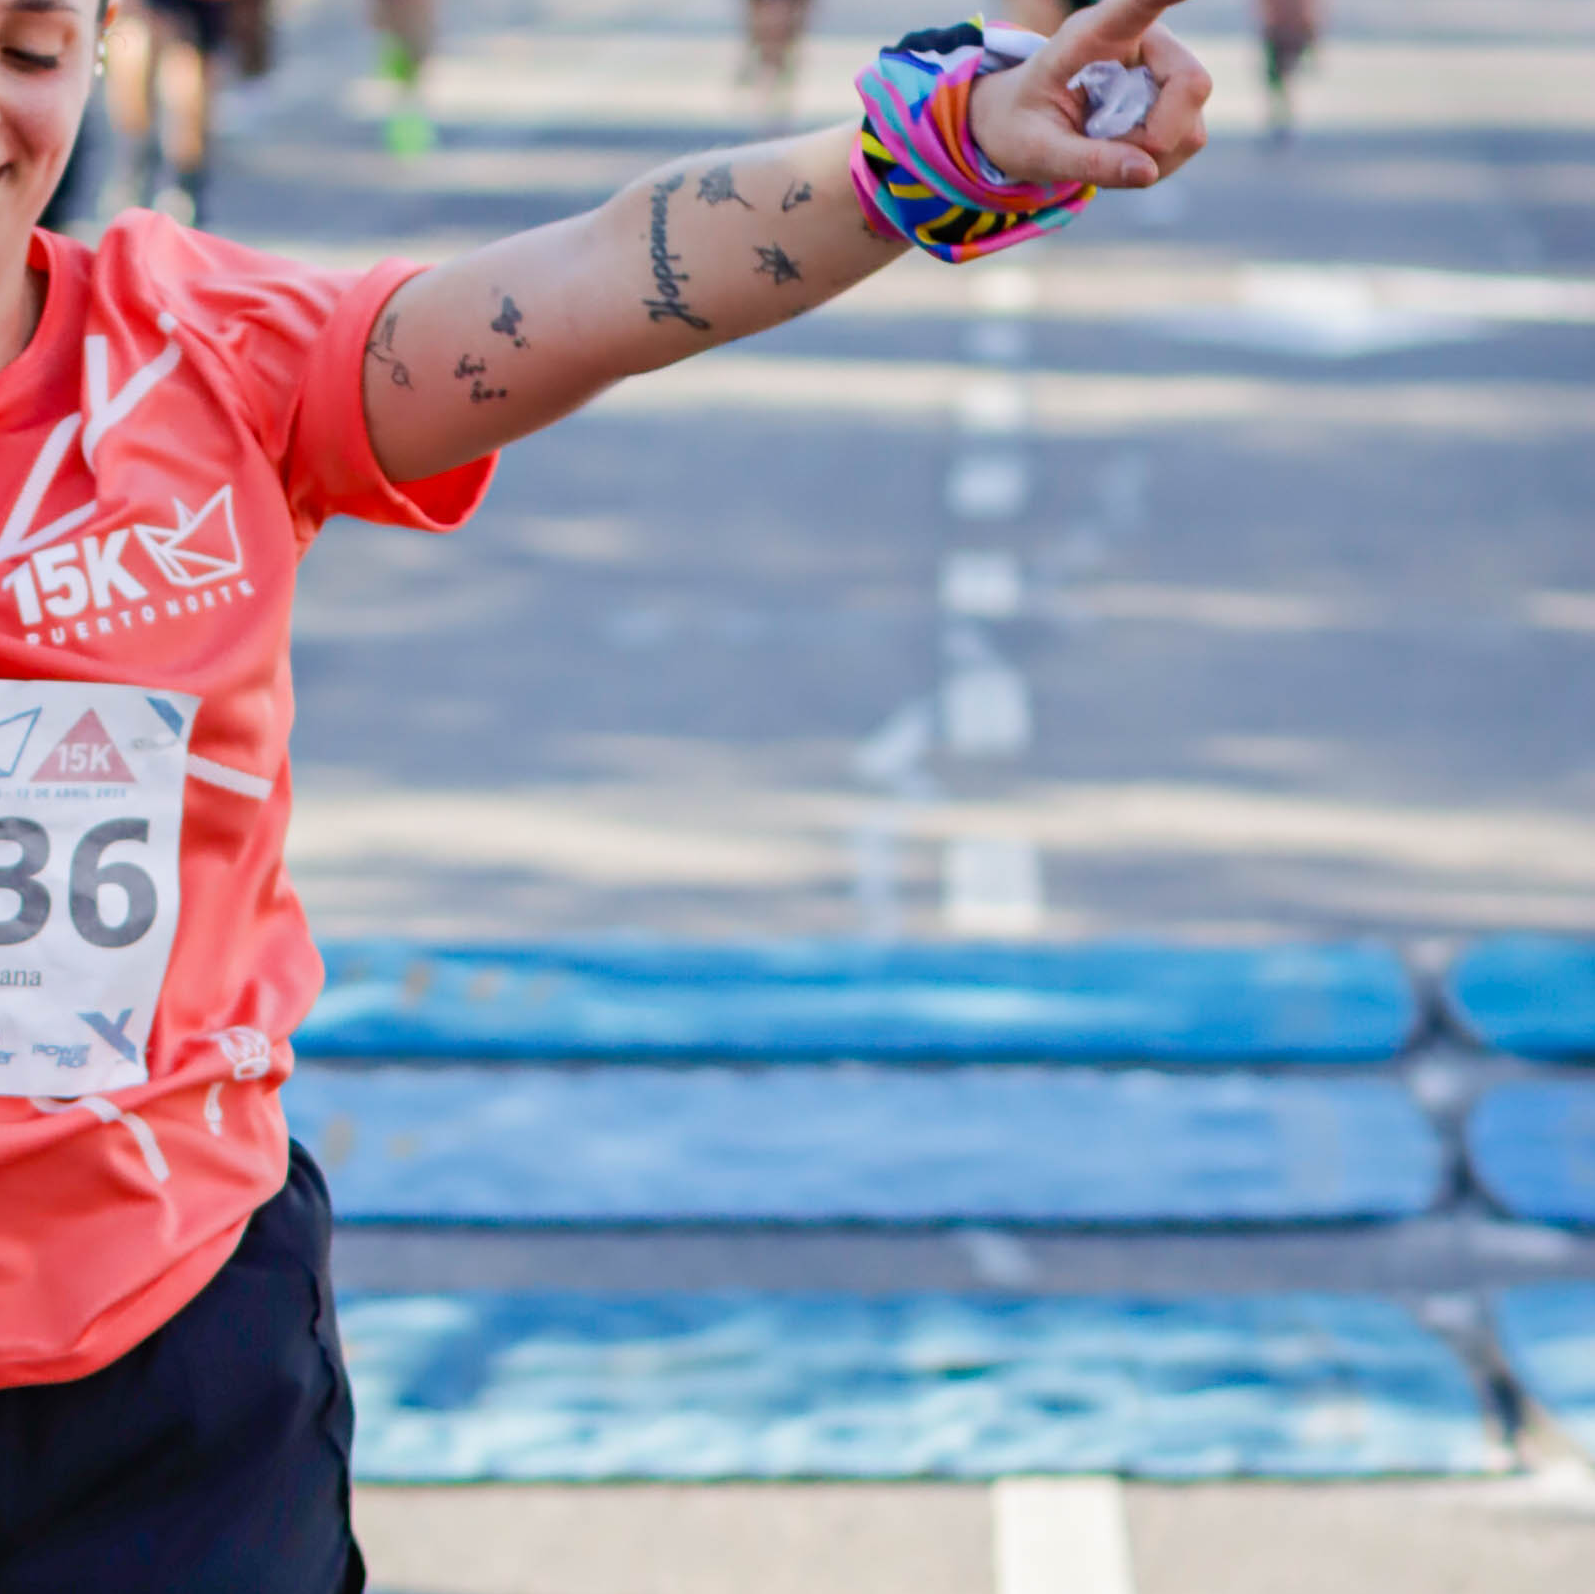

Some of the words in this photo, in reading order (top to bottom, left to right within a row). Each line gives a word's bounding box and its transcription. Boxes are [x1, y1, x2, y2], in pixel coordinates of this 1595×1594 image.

[1, 528, 148, 627] 15K
[26, 605, 156, 645] PUERTO
[166, 579, 255, 617] NORTE
[55, 741, 112, 773] 15K
